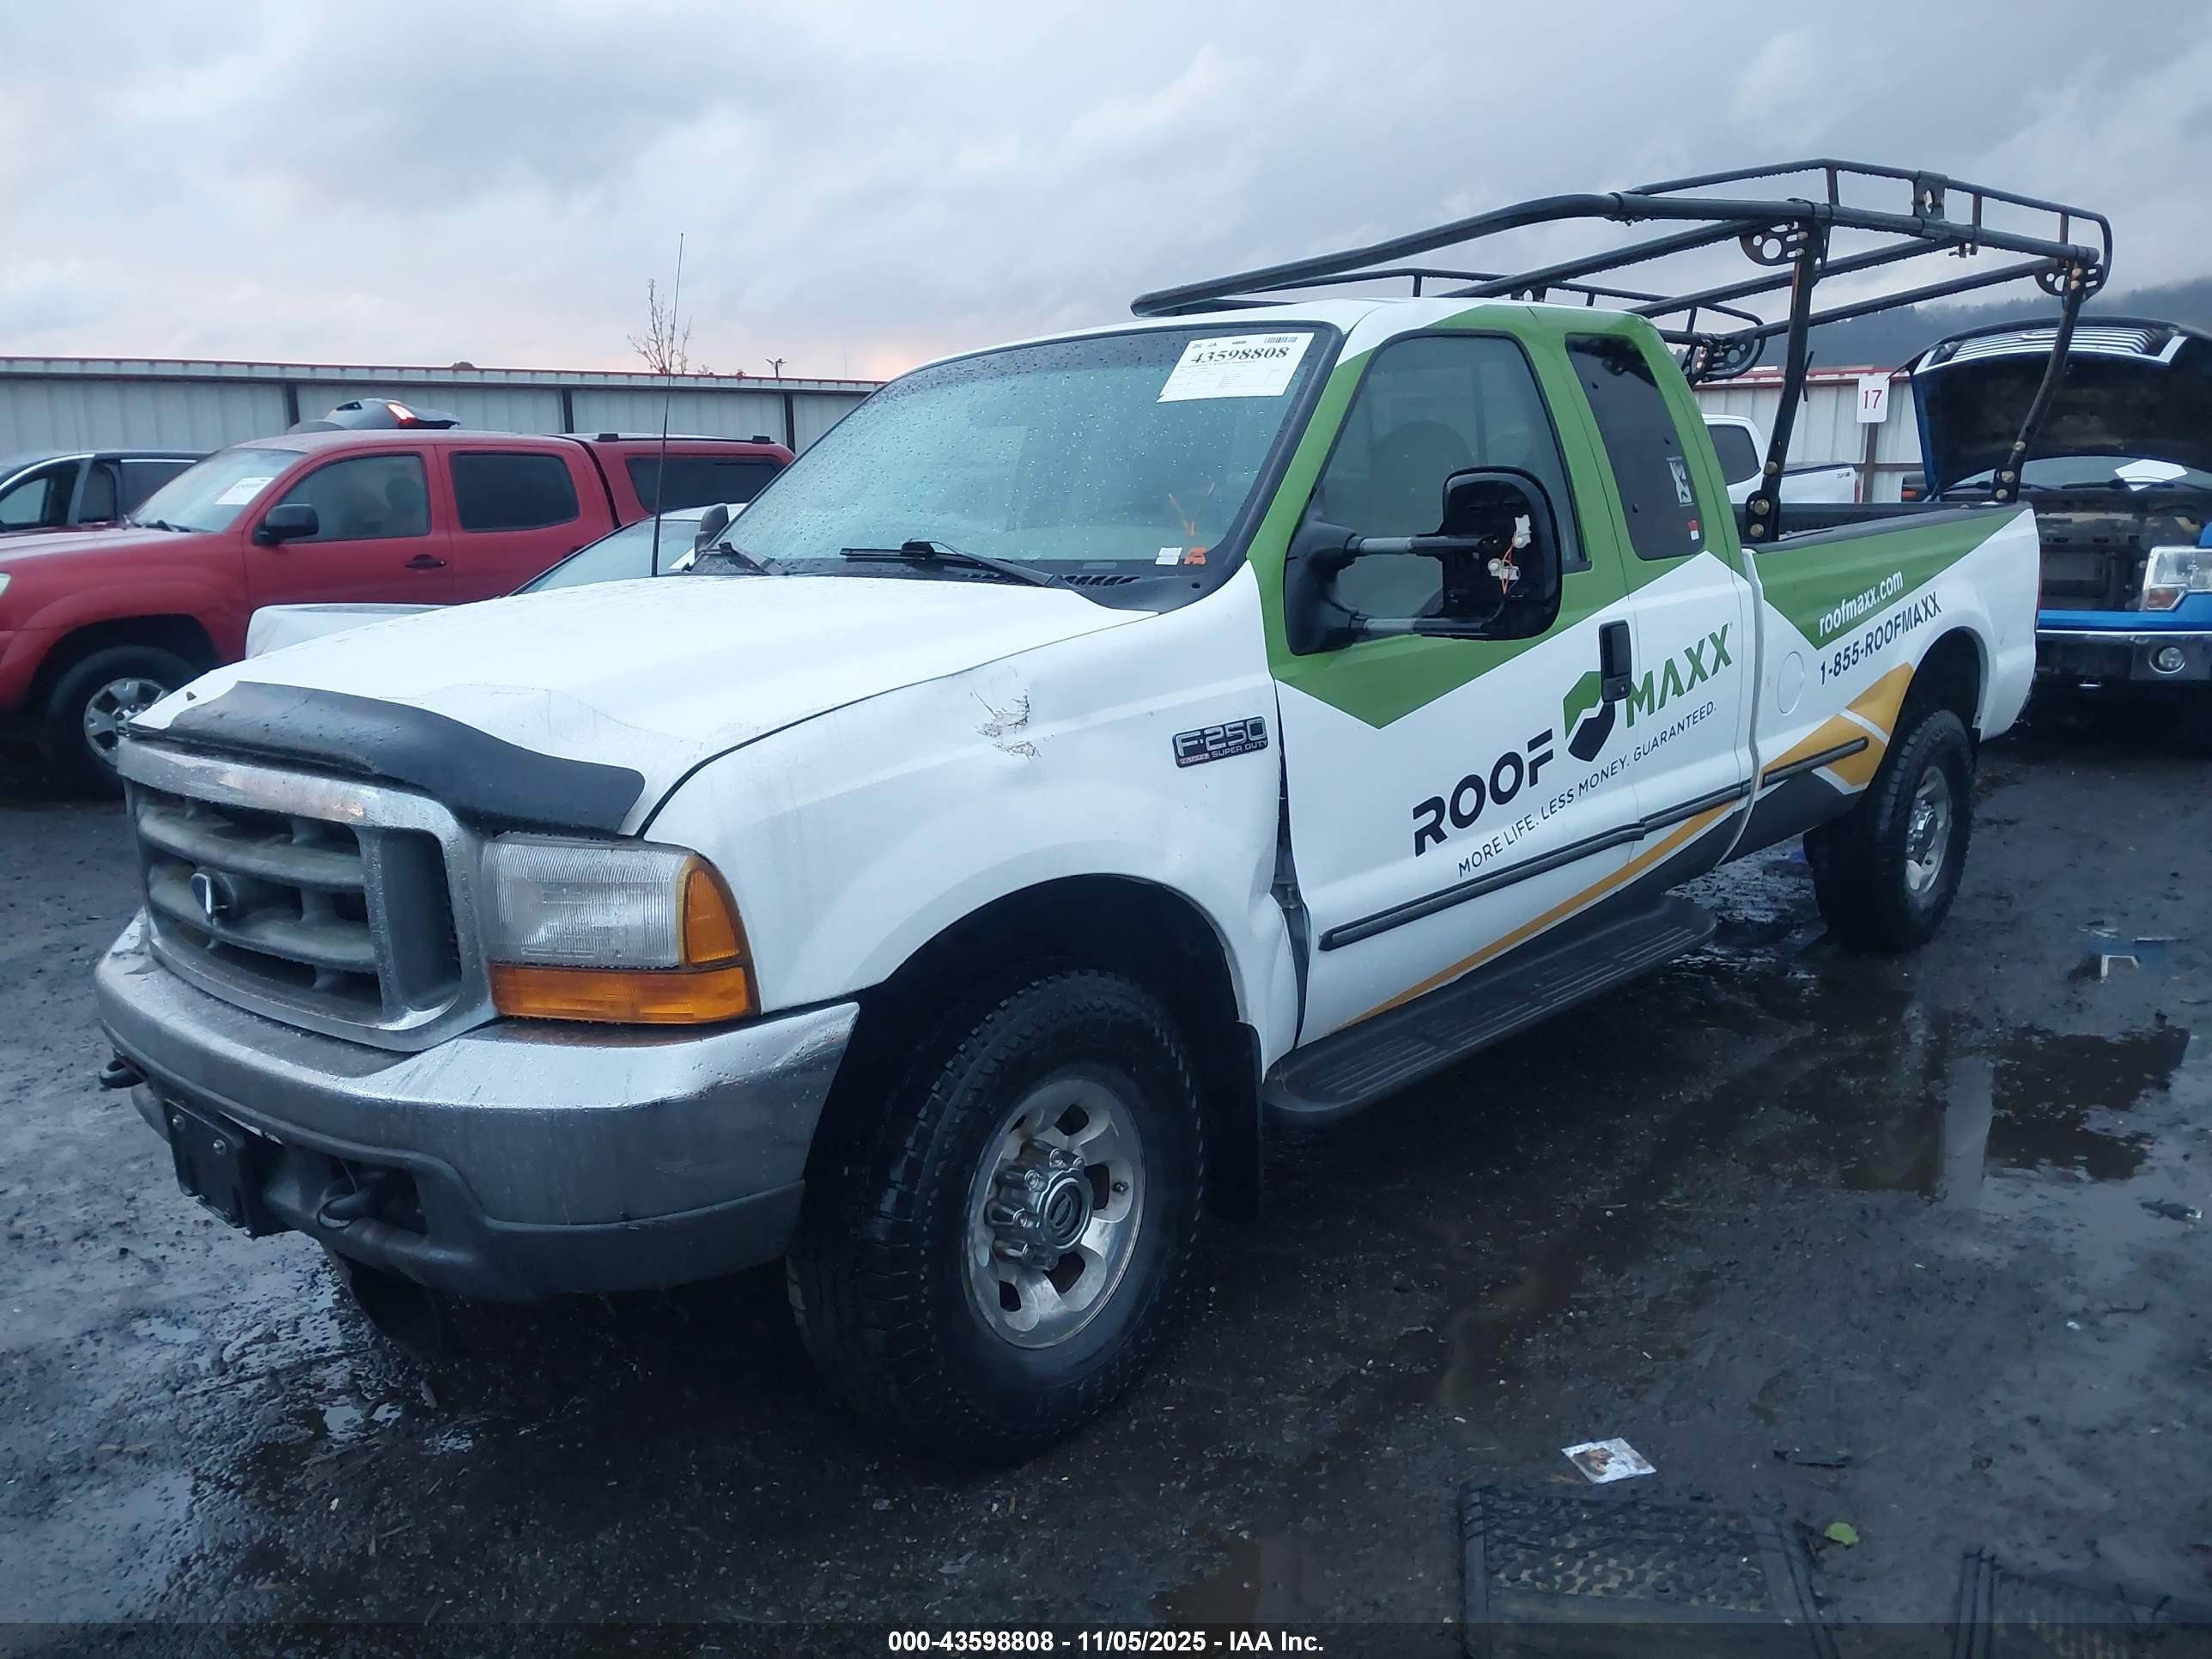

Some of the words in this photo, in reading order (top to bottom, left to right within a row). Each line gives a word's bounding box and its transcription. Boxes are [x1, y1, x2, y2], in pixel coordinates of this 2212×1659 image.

[1190, 346, 1291, 364] 43598808
[1863, 389, 1883, 410] 17
[1818, 569, 1904, 638] roofmaxx.com
[1820, 590, 1942, 686] 1-855-ROOFMAXX
[1212, 745, 1243, 757] SUPER
[1246, 740, 1267, 750] DUTY
[1413, 727, 1554, 858] ROOF
[1626, 623, 1733, 729] MAXX
[1458, 836, 1504, 878] MORE
[1504, 815, 1540, 846] LIFE.
[1540, 788, 1575, 821] LESS
[1578, 754, 1631, 800] MONEY.
[1633, 700, 1717, 763] GUARANTEED.
